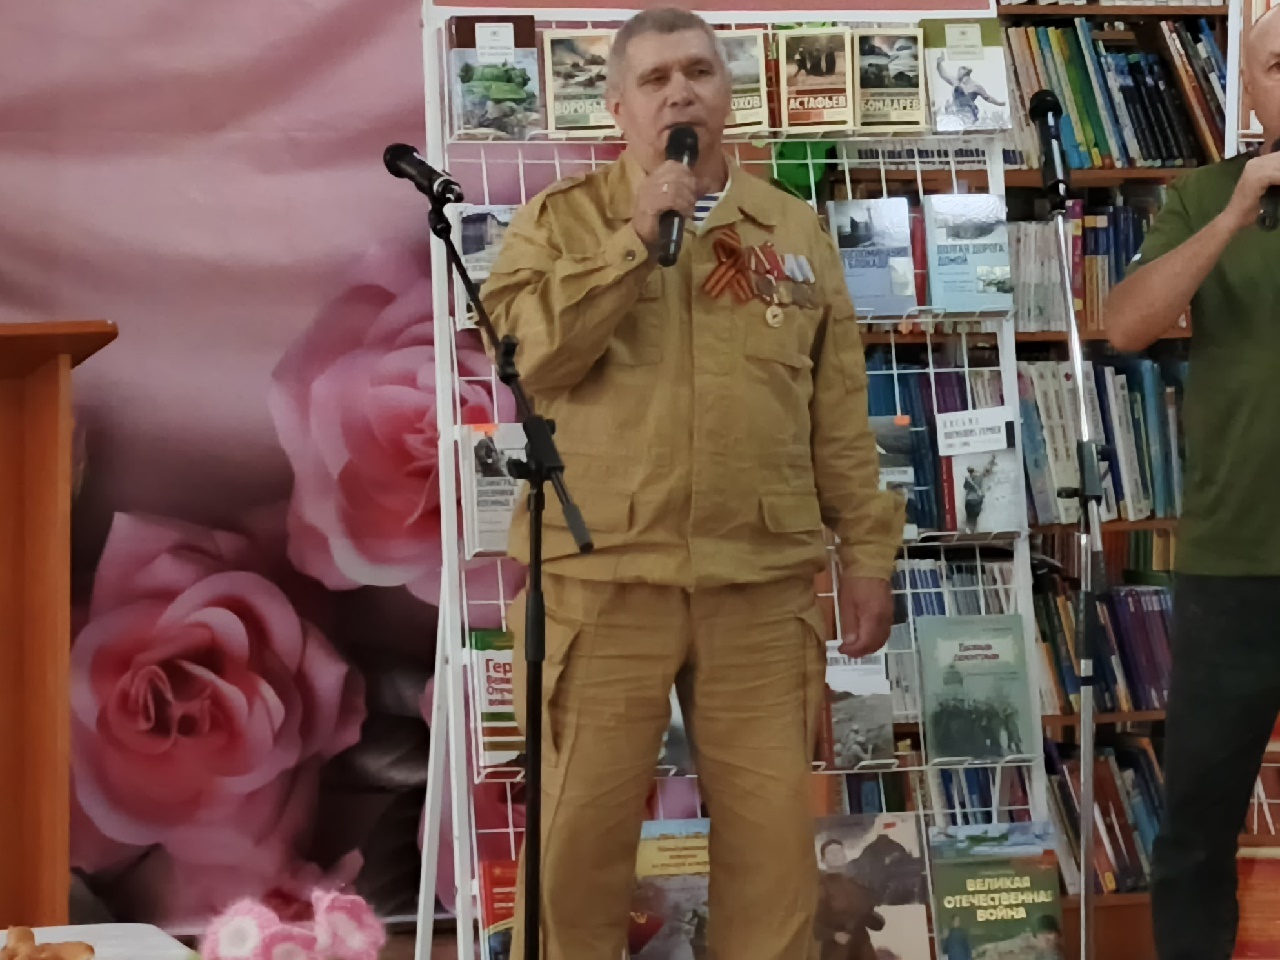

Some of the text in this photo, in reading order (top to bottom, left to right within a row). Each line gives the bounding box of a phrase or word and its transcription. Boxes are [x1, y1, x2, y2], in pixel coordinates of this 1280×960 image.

[554, 101, 606, 115] ВОРОБЬЕ
[788, 96, 847, 109] АСТАФЬЕВ
[965, 876, 1031, 891] ВЕЛИКАЯ
[976, 906, 1027, 922] ВОЙНА
